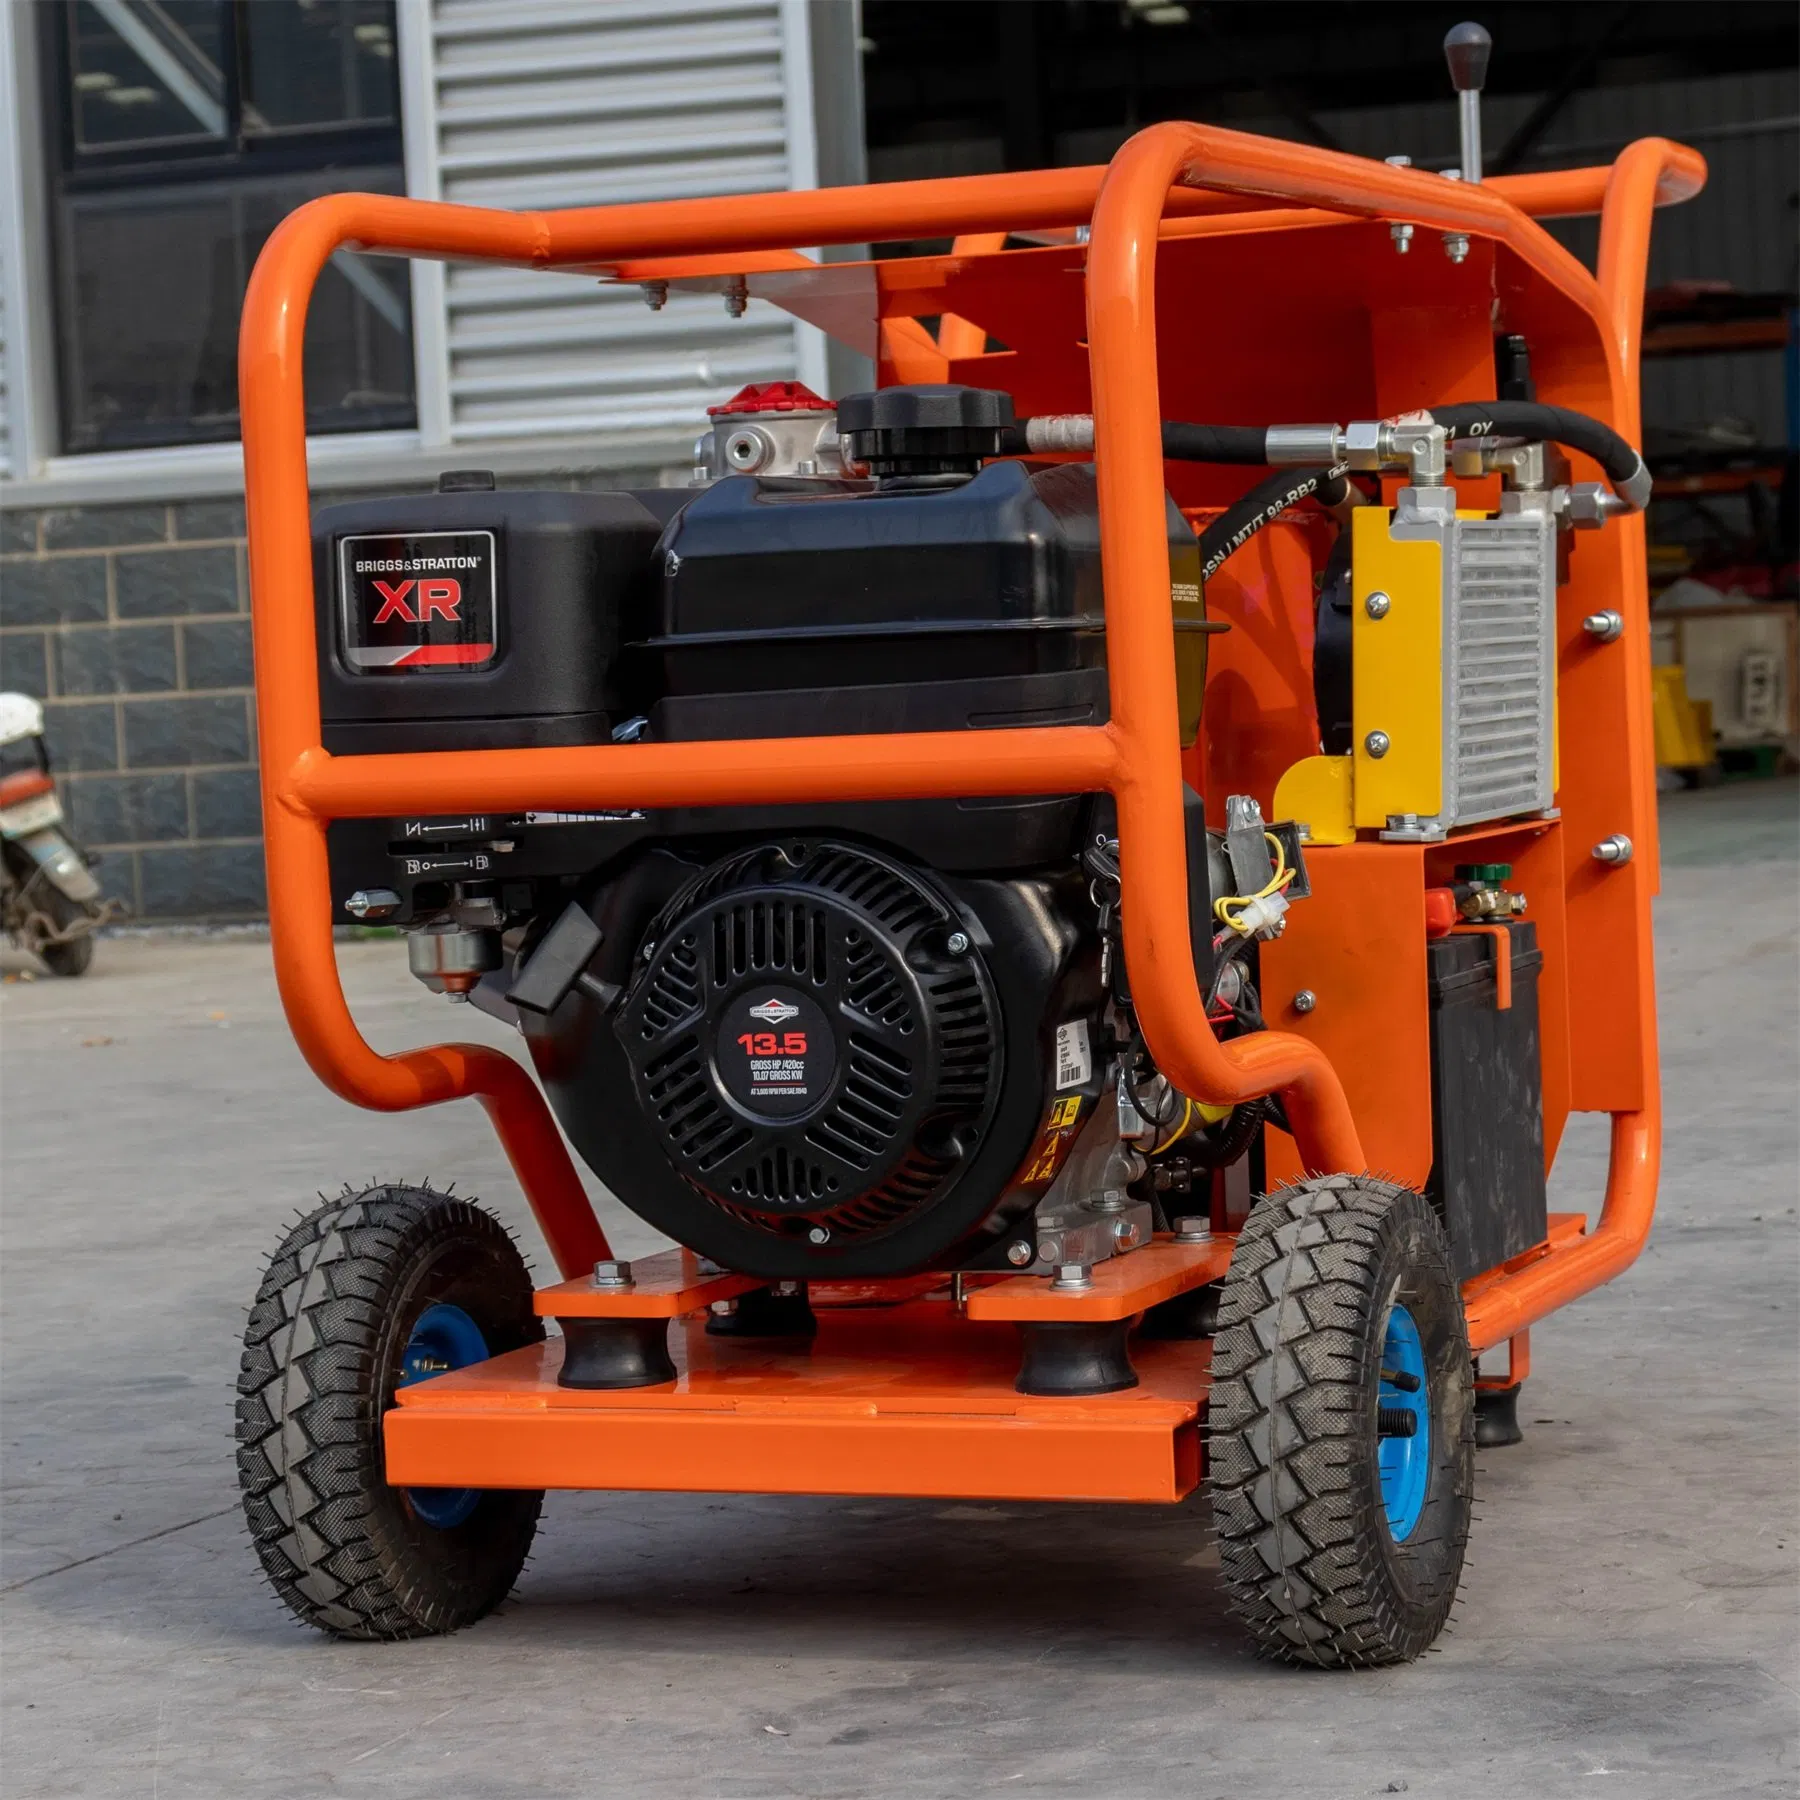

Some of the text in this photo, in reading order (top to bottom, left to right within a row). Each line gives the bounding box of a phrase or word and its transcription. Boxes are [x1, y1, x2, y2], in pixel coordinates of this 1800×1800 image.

[1469, 421, 1494, 436] OY
[1202, 549, 1227, 581] 2SN
[1231, 513, 1265, 547] MT/T
[371, 577, 462, 624] XR
[737, 1032, 808, 1056] 13.5
[750, 1060, 772, 1070] GROSS
[772, 1060, 782, 1070] HP
[753, 1070, 803, 1081] 10.07 GROSS KW
